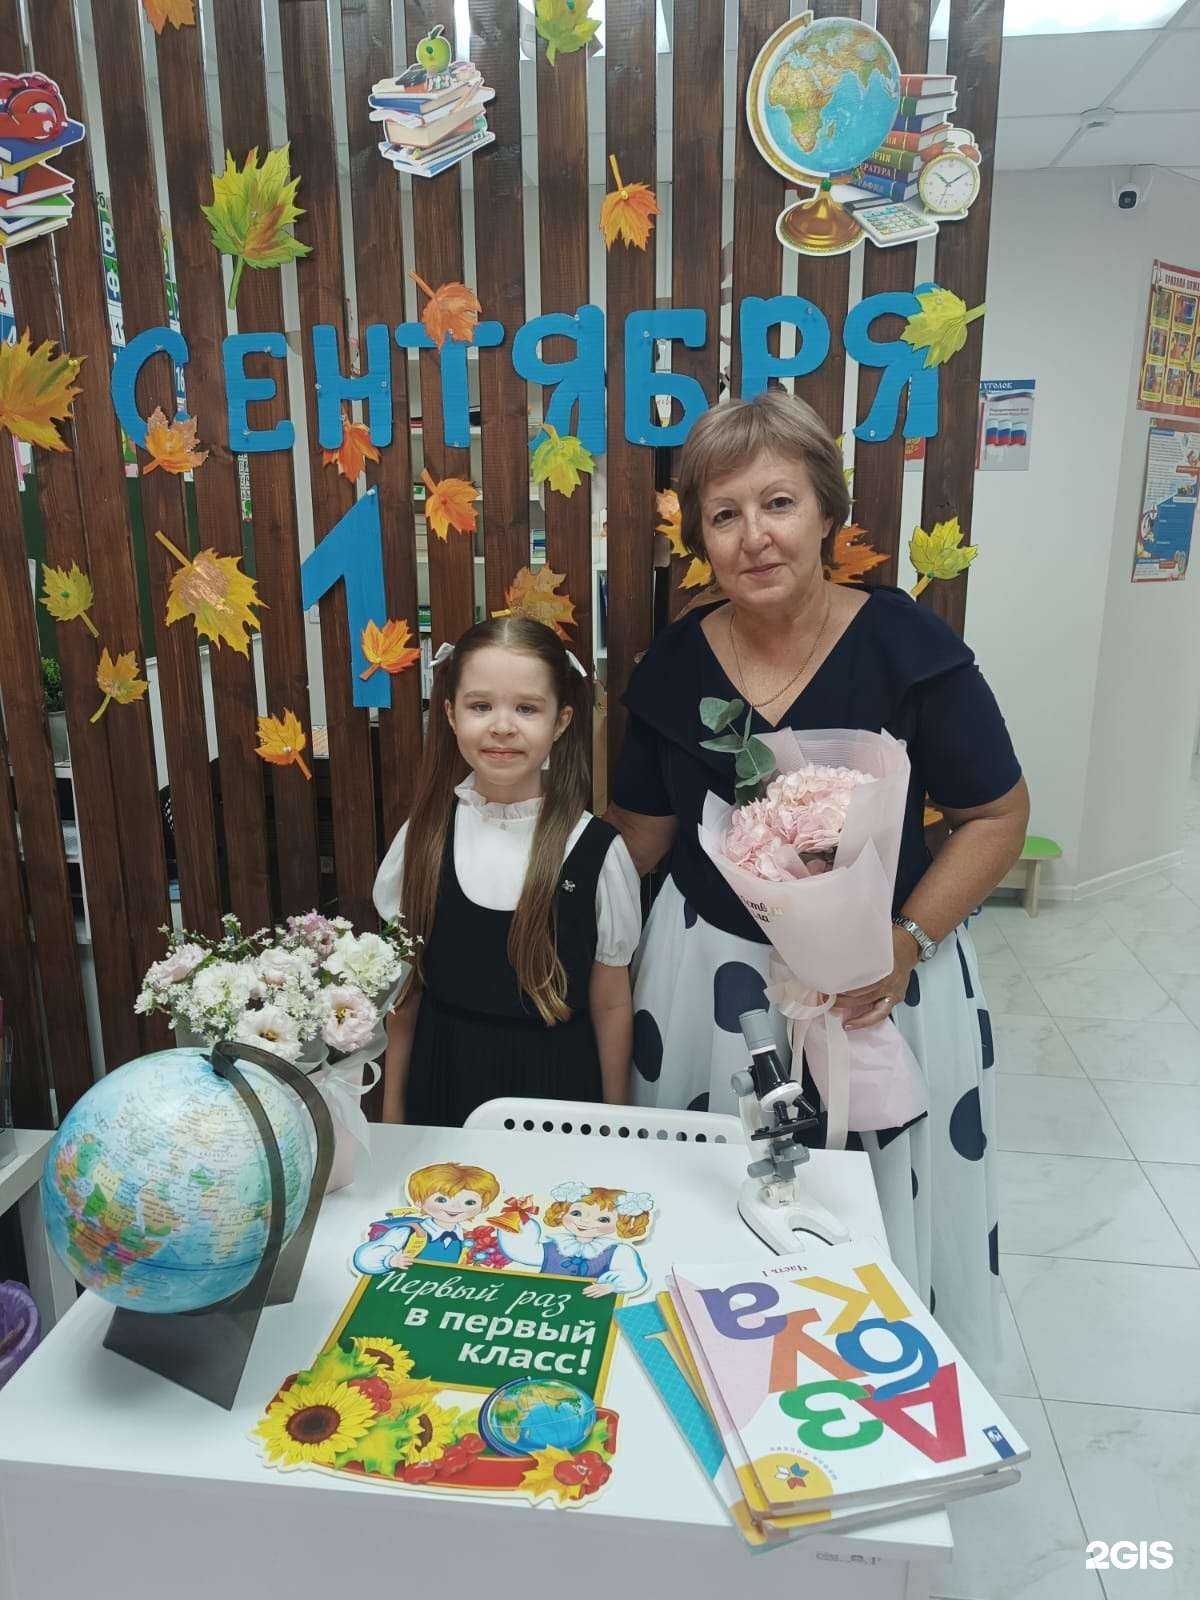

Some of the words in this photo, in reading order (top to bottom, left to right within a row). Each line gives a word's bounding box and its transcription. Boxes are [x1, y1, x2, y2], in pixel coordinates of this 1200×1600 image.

[111, 281, 940, 455] СЕНТЯБРЯ
[301, 486, 392, 708] 1
[376, 1270, 505, 1306] Первый
[505, 1288, 572, 1319] раз
[404, 1307, 431, 1327] в
[438, 1311, 597, 1346] первый
[458, 1342, 592, 1376] класс!
